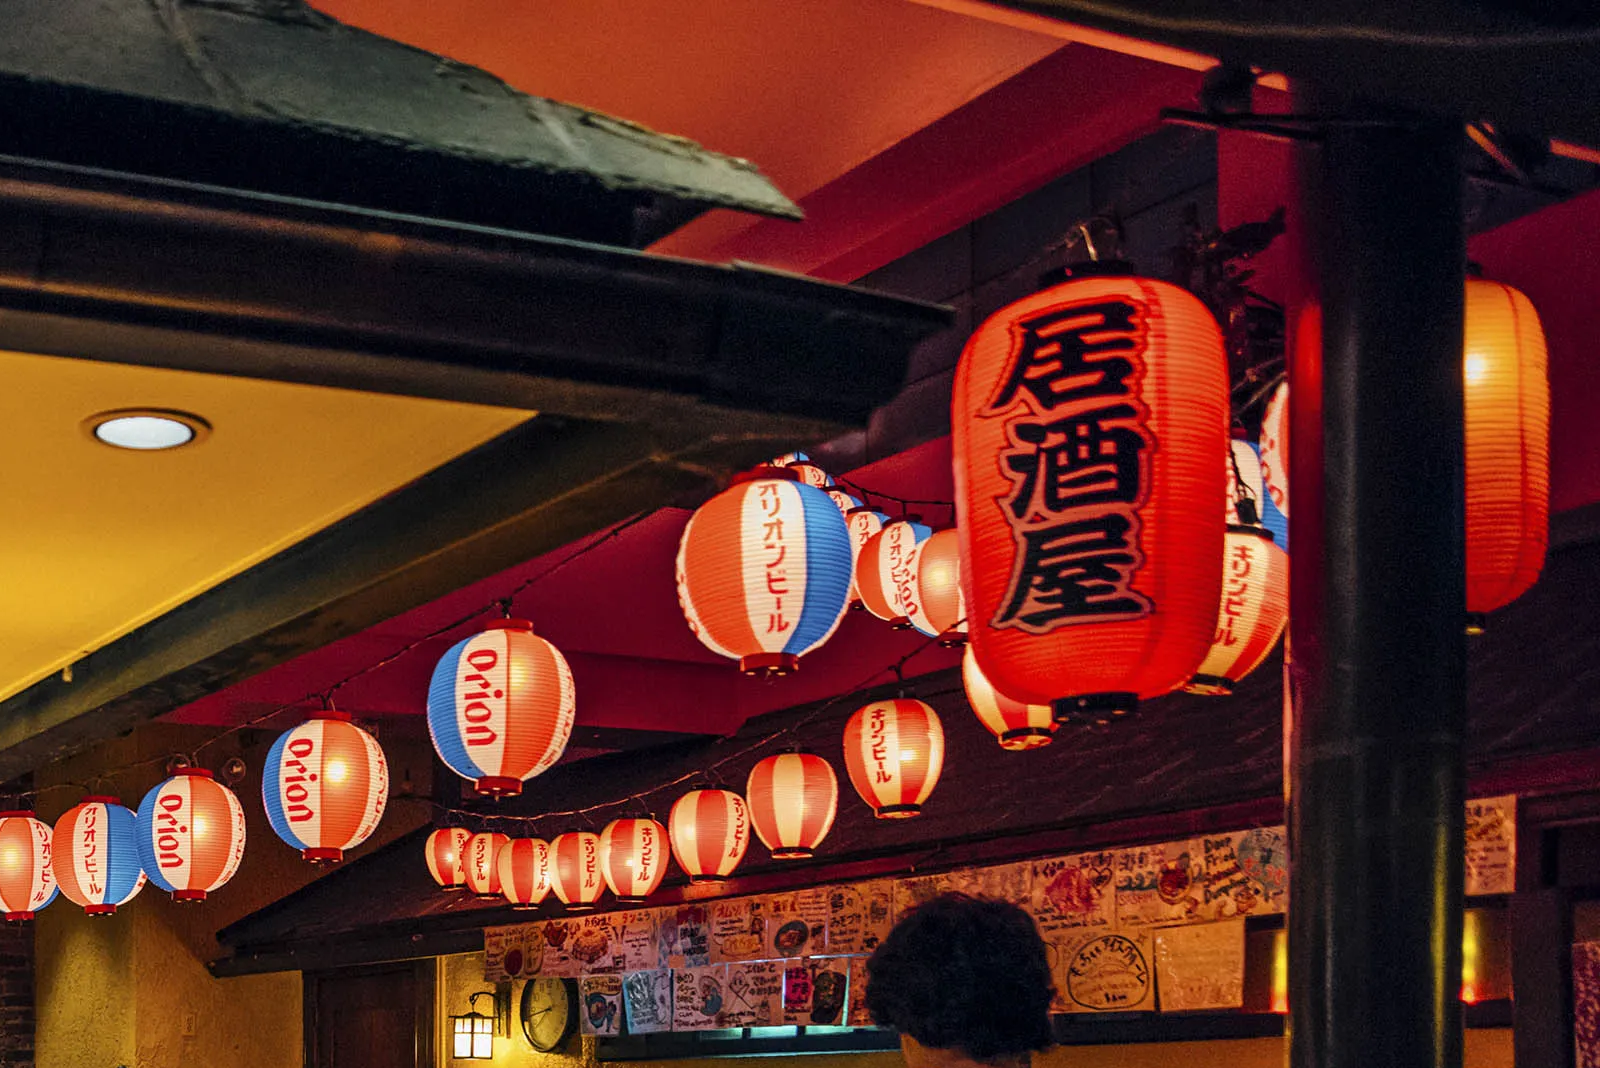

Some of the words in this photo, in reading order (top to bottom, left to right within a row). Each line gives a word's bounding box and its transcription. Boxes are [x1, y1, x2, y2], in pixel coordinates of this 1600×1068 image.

[989, 300, 1150, 628] 居酒屋
[758, 483, 790, 633] オリオンビール
[1194, 545, 1253, 647] キリンビール
[464, 649, 503, 746] Orion
[285, 738, 317, 822] Orion
[871, 708, 891, 784] キリンビール
[33, 822, 52, 901] オリオンビール
[83, 807, 102, 895] オリオンビール
[157, 794, 188, 868] Orion
[476, 838, 486, 881] キリンビール
[584, 838, 596, 888] キリンビール
[637, 827, 652, 882] キリンビール
[728, 797, 746, 859] キリンビール
[536, 844, 548, 890] キリンビール
